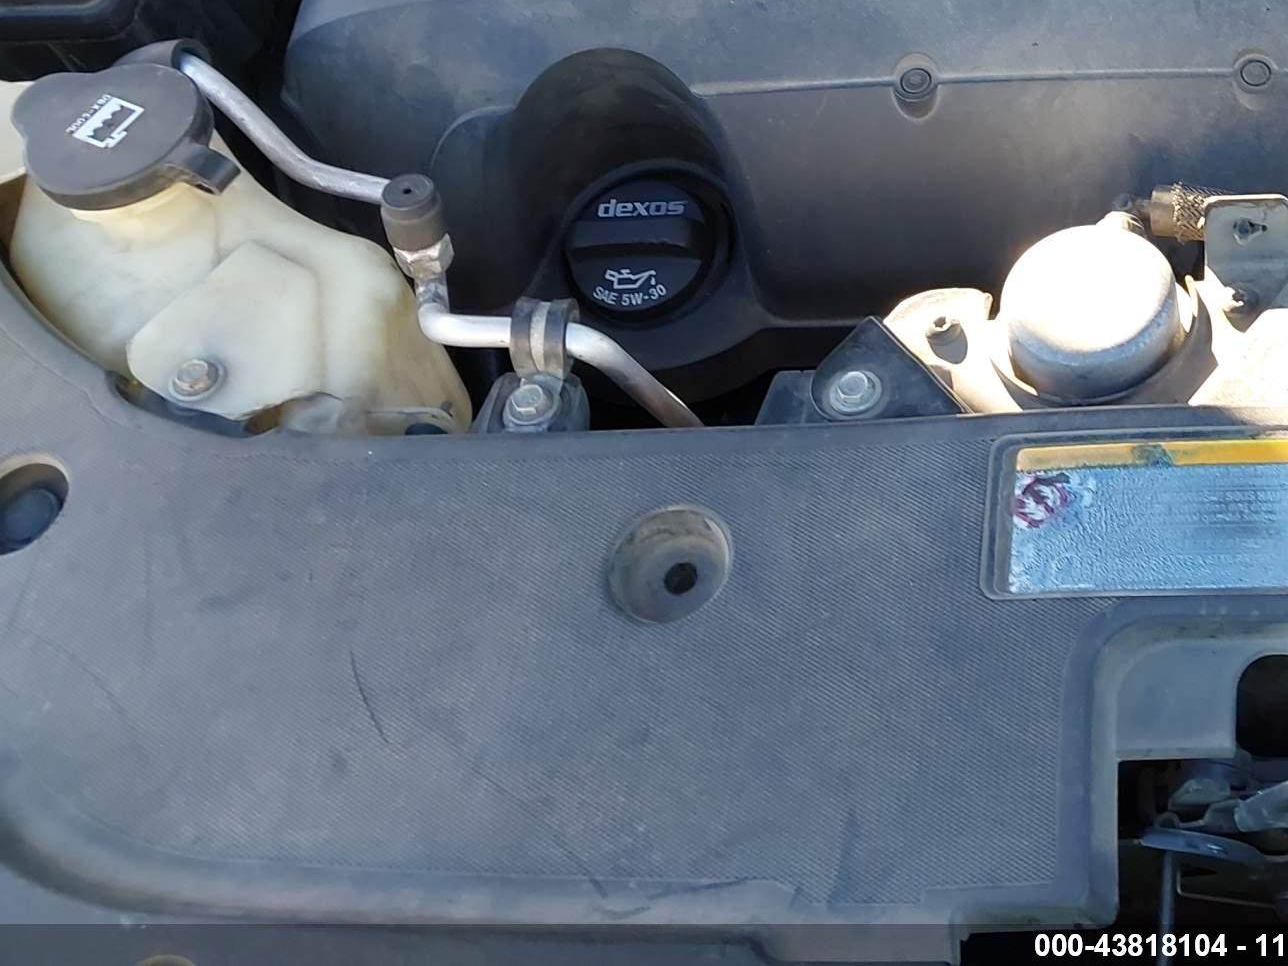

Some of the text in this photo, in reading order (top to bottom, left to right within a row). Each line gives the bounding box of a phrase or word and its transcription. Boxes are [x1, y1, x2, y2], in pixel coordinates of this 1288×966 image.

[598, 199, 687, 218] dexos
[593, 284, 667, 306] SAE 5W-30
